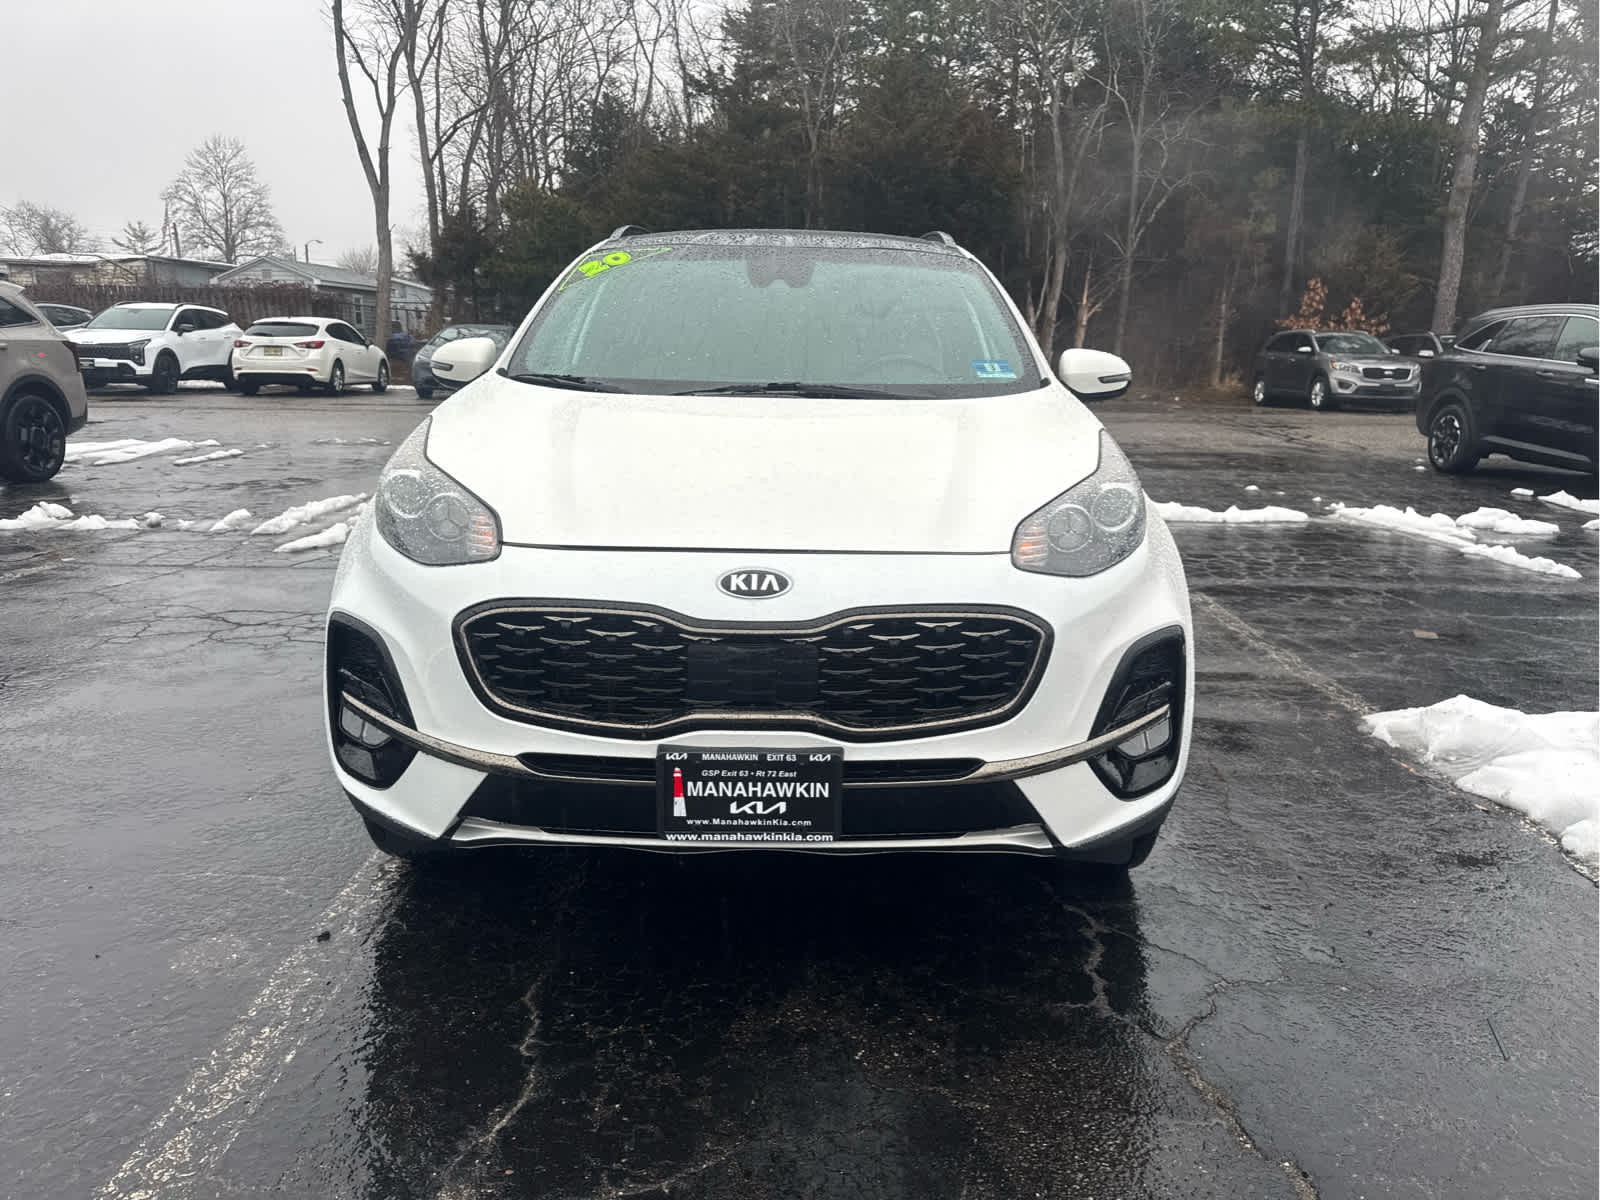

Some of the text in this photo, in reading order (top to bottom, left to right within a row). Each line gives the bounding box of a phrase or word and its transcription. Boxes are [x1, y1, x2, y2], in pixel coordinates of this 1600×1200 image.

[579, 251, 631, 277] 20
[730, 573, 780, 591] KIA
[702, 753, 797, 762] MANAHAWKIN EXIT 63
[701, 769, 720, 777] GSP
[778, 770, 797, 778] East
[686, 781, 830, 798] MANAHAWKIN
[686, 818, 812, 826] www.ManahawkinKia.com
[666, 833, 834, 842] www.manahawkinkia.com
